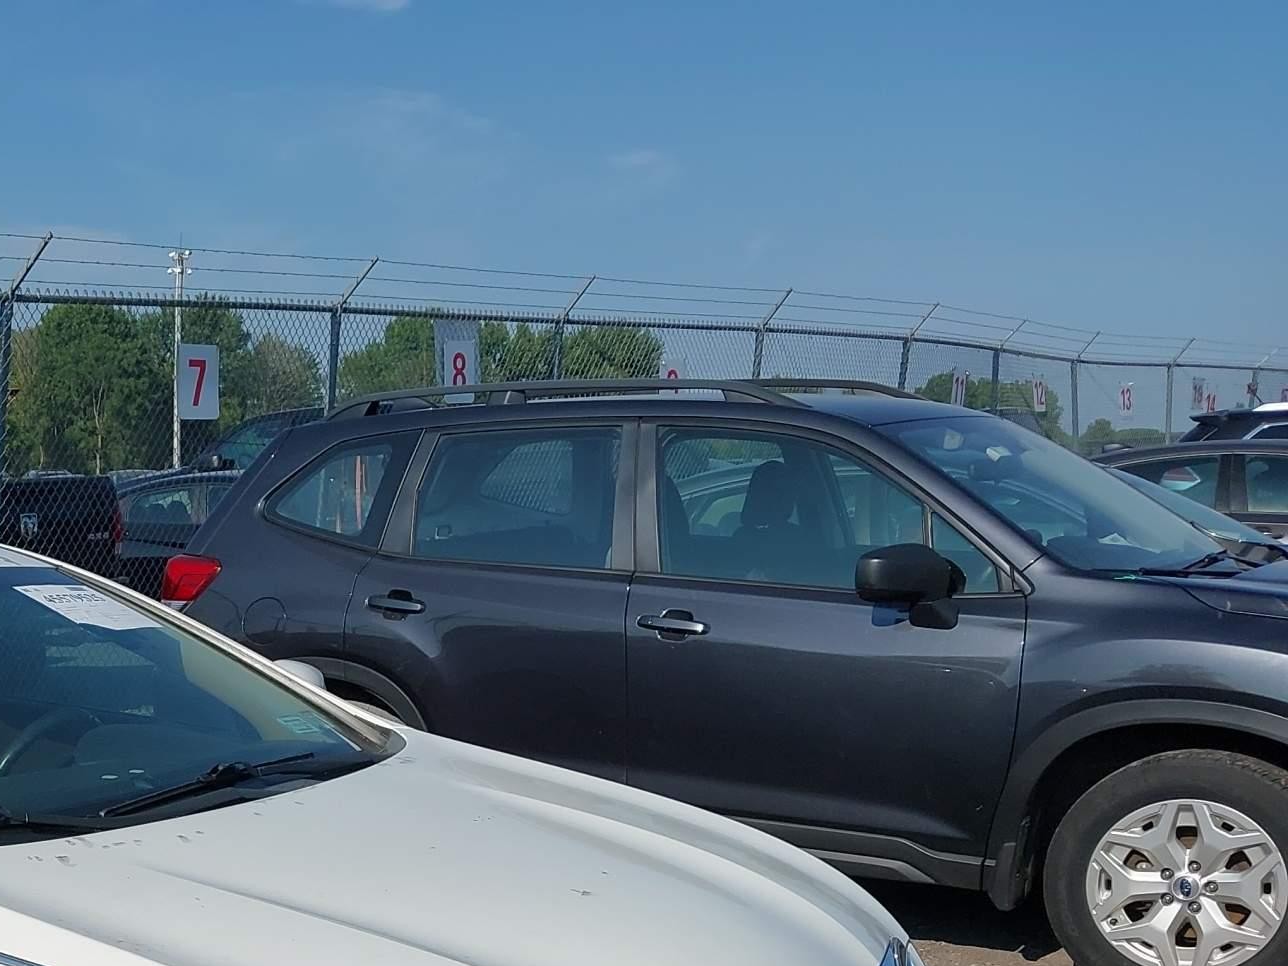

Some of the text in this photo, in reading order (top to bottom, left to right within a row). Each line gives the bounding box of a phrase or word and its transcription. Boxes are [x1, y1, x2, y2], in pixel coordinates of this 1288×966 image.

[452, 352, 466, 385] 8
[188, 359, 207, 407] 7
[955, 375, 965, 402] 11
[1034, 381, 1045, 406] 12
[1120, 387, 1132, 411] 13
